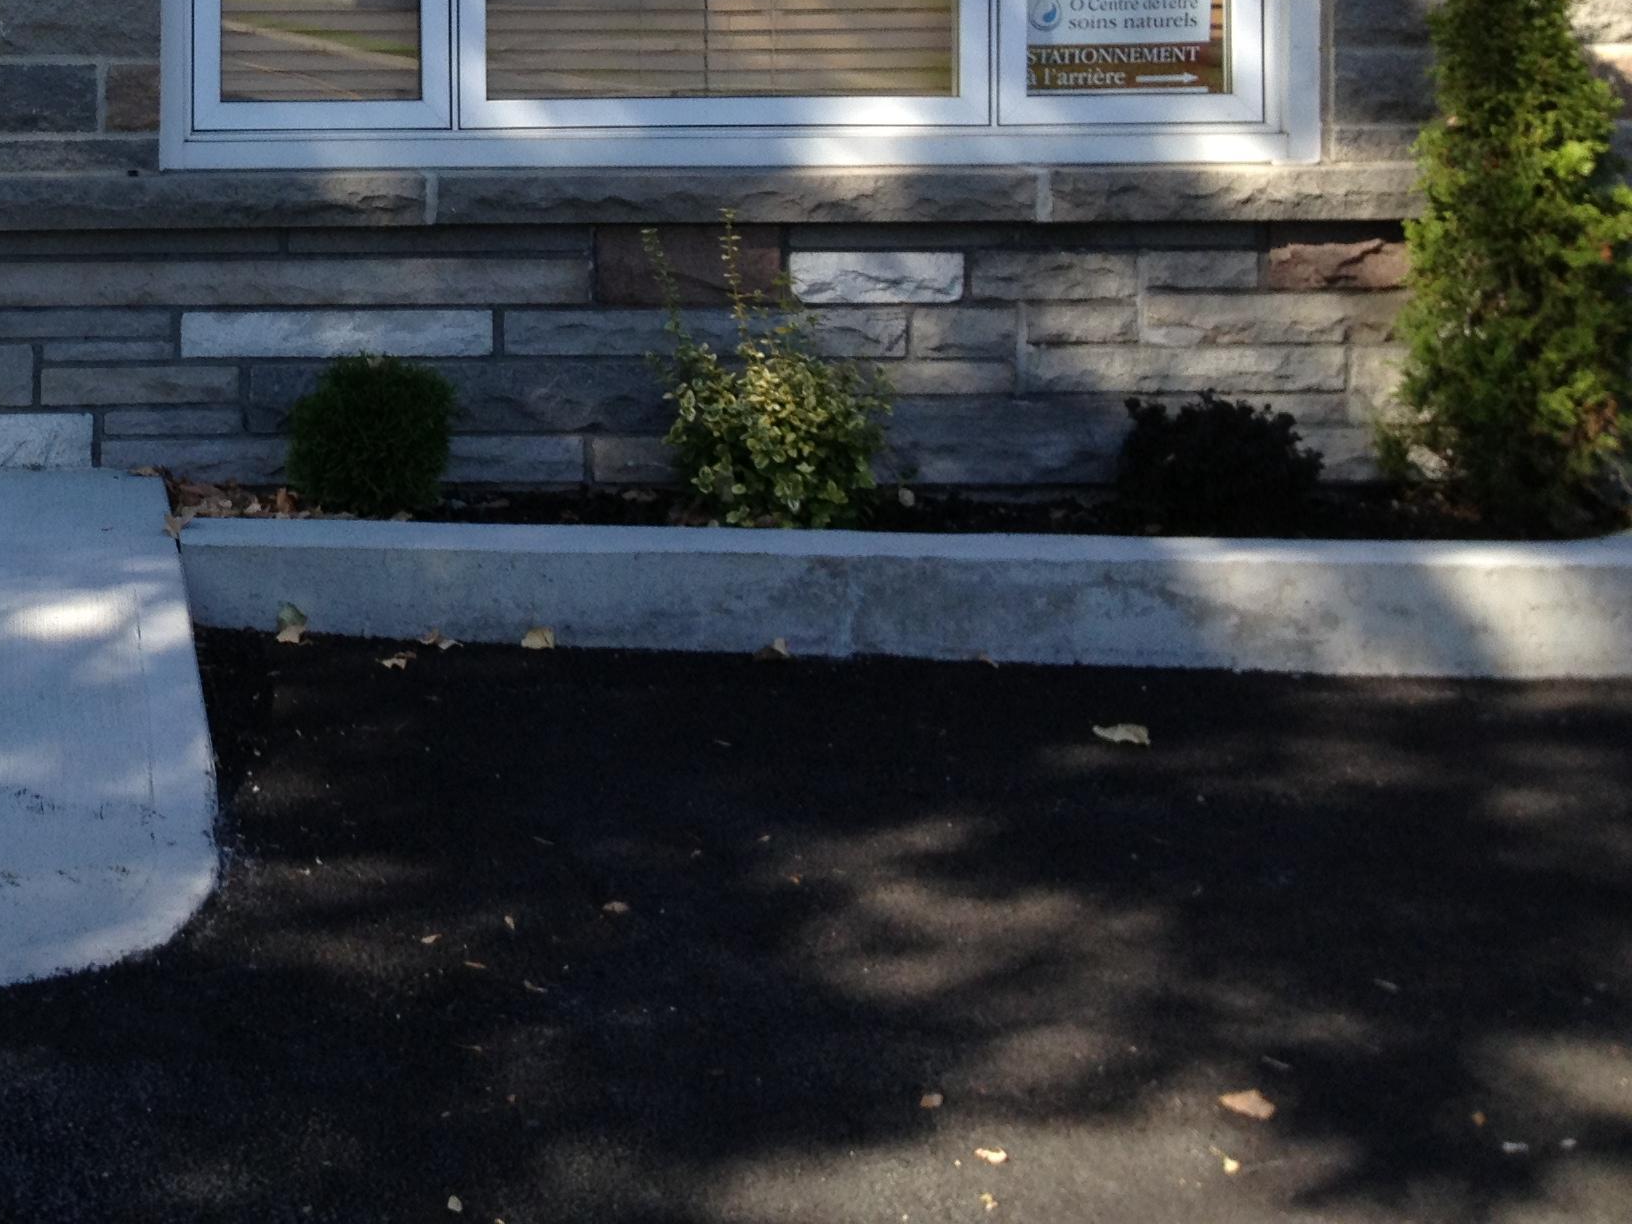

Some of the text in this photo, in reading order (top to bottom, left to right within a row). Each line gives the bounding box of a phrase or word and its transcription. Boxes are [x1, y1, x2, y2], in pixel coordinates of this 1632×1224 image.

[1068, 12, 1198, 31] soins naturels
[1027, 45, 1200, 65] STATIONNEMENT
[1044, 67, 1127, 86] l'arrière
